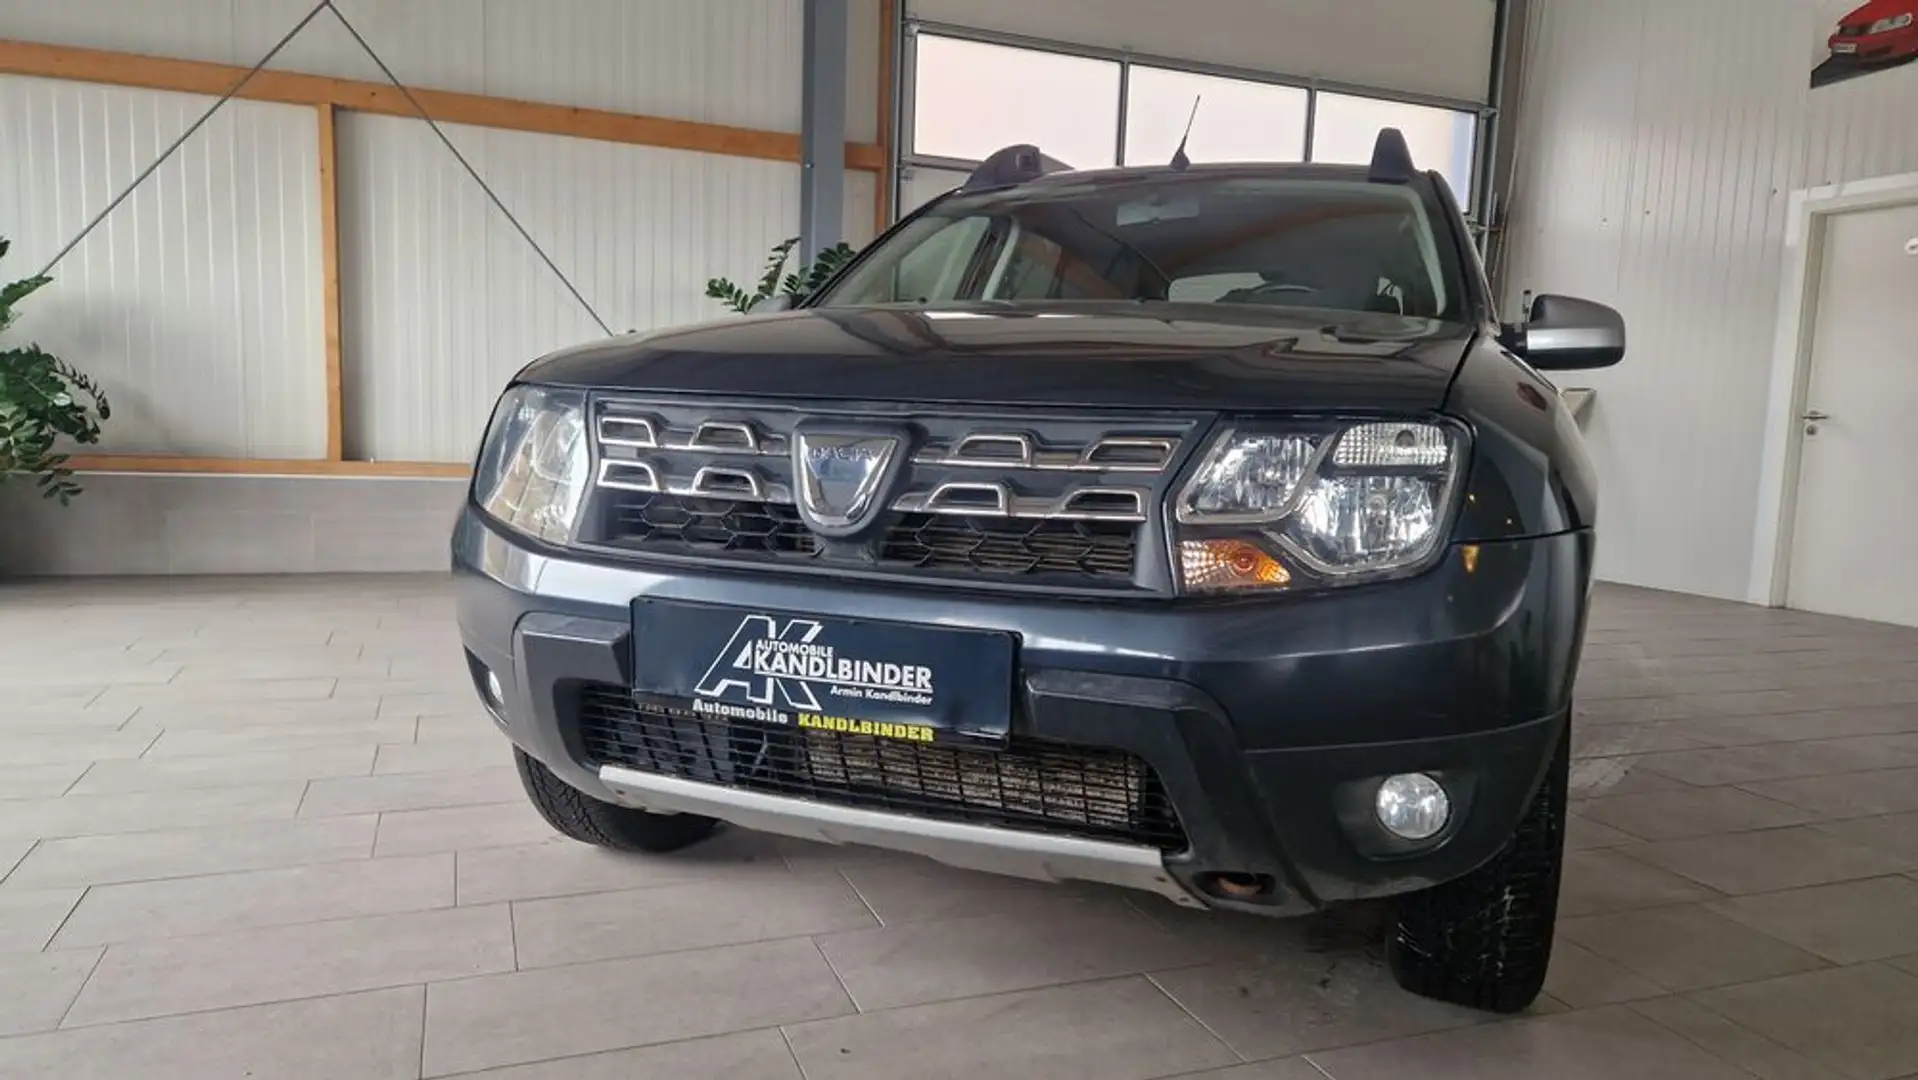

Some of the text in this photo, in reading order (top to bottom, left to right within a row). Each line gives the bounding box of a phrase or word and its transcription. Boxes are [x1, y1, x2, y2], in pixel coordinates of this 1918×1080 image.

[811, 446, 874, 462] DACIA
[755, 639, 834, 658] AUTOMOBILE
[754, 649, 933, 690] KANDLBINDER
[830, 684, 933, 706] Armin Kandlbinder
[693, 698, 934, 742] Automobile KANDLBINDER
